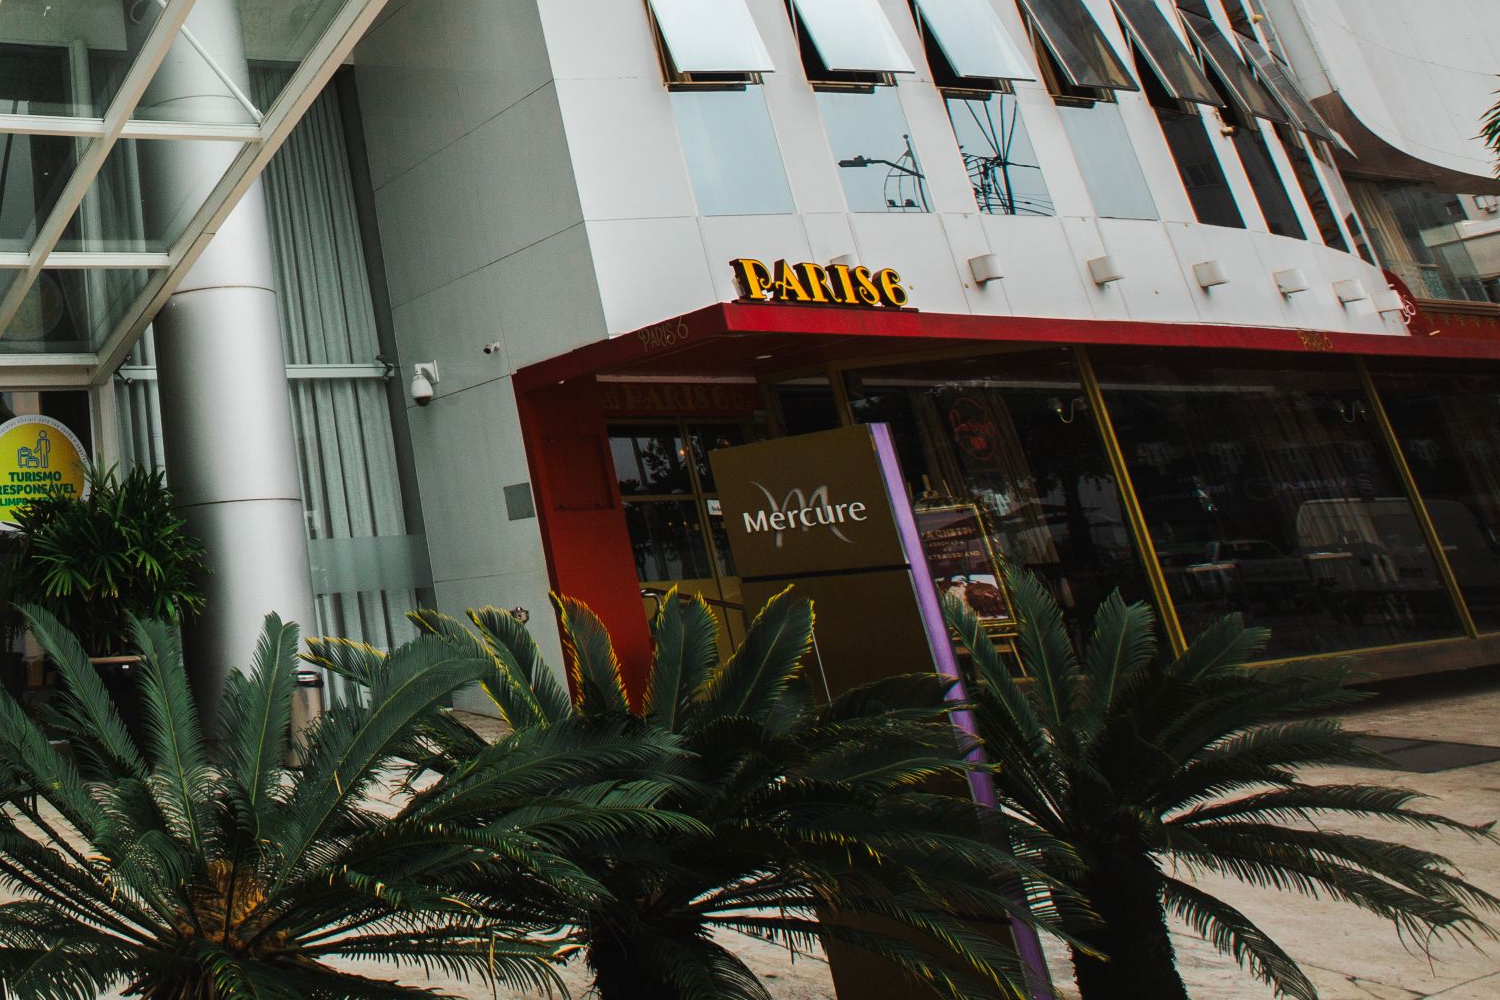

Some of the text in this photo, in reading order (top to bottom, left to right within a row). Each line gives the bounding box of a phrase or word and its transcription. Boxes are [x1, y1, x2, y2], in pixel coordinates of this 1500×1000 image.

[638, 315, 690, 353] PARIS 6
[8, 471, 62, 482] TURISMO
[742, 501, 868, 533] Mercure
